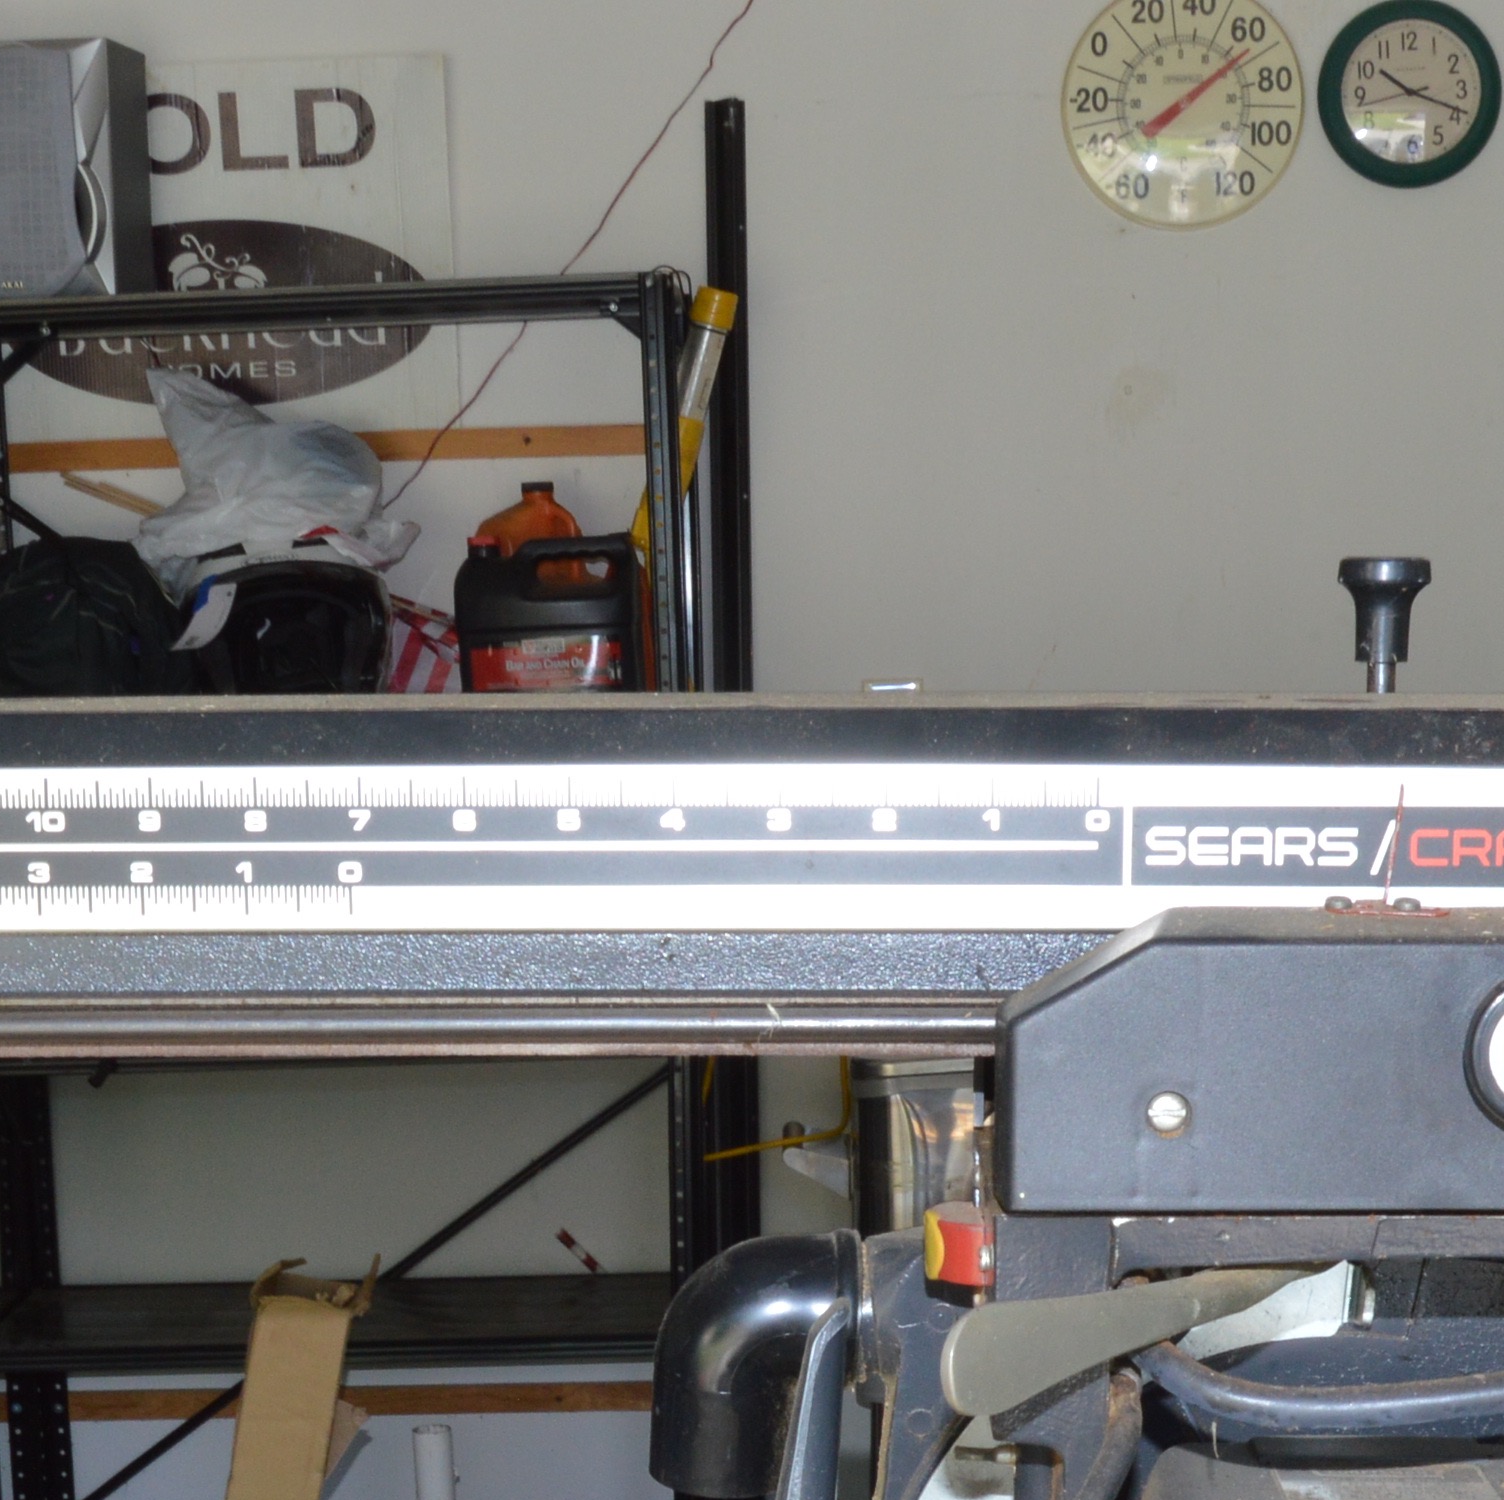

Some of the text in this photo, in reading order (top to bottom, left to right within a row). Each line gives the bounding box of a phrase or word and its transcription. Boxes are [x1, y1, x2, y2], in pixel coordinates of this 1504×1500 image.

[1132, 0, 1164, 23] 20
[1183, 0, 1215, 15] 40
[1231, 17, 1265, 42] 60
[1091, 32, 1108, 56] 0
[1378, 40, 1390, 59] 11
[1401, 31, 1417, 51] 12
[1432, 36, 1436, 54] 1
[1358, 60, 1374, 79] 10
[1448, 54, 1459, 74] 2
[1258, 67, 1292, 91] 80
[1457, 80, 1467, 99] 3
[1070, 88, 1109, 113] -20
[1355, 86, 1366, 107] 9
[1363, 111, 1375, 128] 8
[1450, 105, 1461, 126] 4
[148, 86, 377, 176] OLD
[1251, 121, 1291, 146] 100
[1433, 126, 1444, 145] 5
[1407, 135, 1419, 154] 6
[1106, 174, 1149, 199] -60
[1215, 171, 1255, 196] 120
[26, 810, 65, 832] 10
[138, 810, 161, 832] 9
[244, 810, 267, 832] 8
[348, 809, 371, 831] 7
[452, 808, 477, 832] 6
[557, 808, 581, 831] 5
[660, 808, 686, 831] 4
[766, 808, 792, 831] 3
[872, 808, 897, 832] 2
[983, 807, 1002, 832] 1
[1084, 808, 1111, 832] 0
[1144, 825, 1359, 868] SEARS
[28, 862, 50, 884] 3
[130, 861, 154, 883] 2
[236, 861, 253, 883] 1
[337, 860, 363, 883] 0
